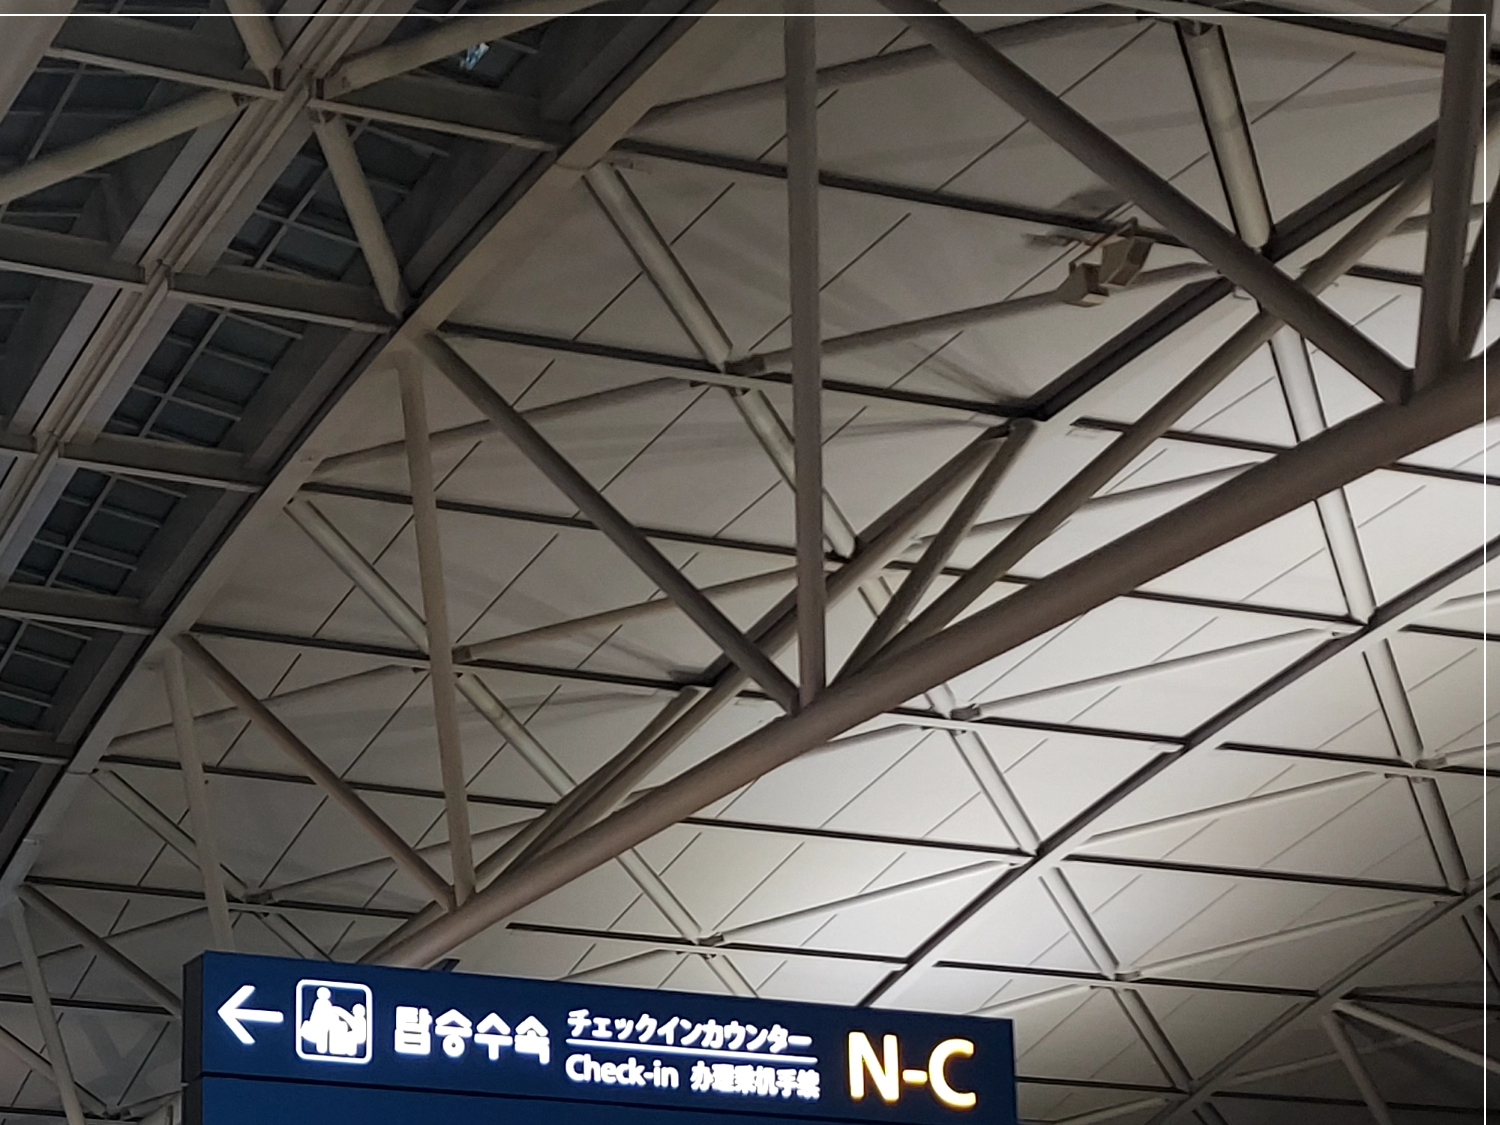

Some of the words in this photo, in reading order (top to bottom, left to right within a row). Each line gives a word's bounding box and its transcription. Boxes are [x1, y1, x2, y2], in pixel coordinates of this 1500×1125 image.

[394, 1005, 550, 1064] 탑승수속
[567, 1008, 813, 1054] チェックインカウンター
[565, 1054, 679, 1088] Check-in
[846, 1030, 977, 1108] N-C
